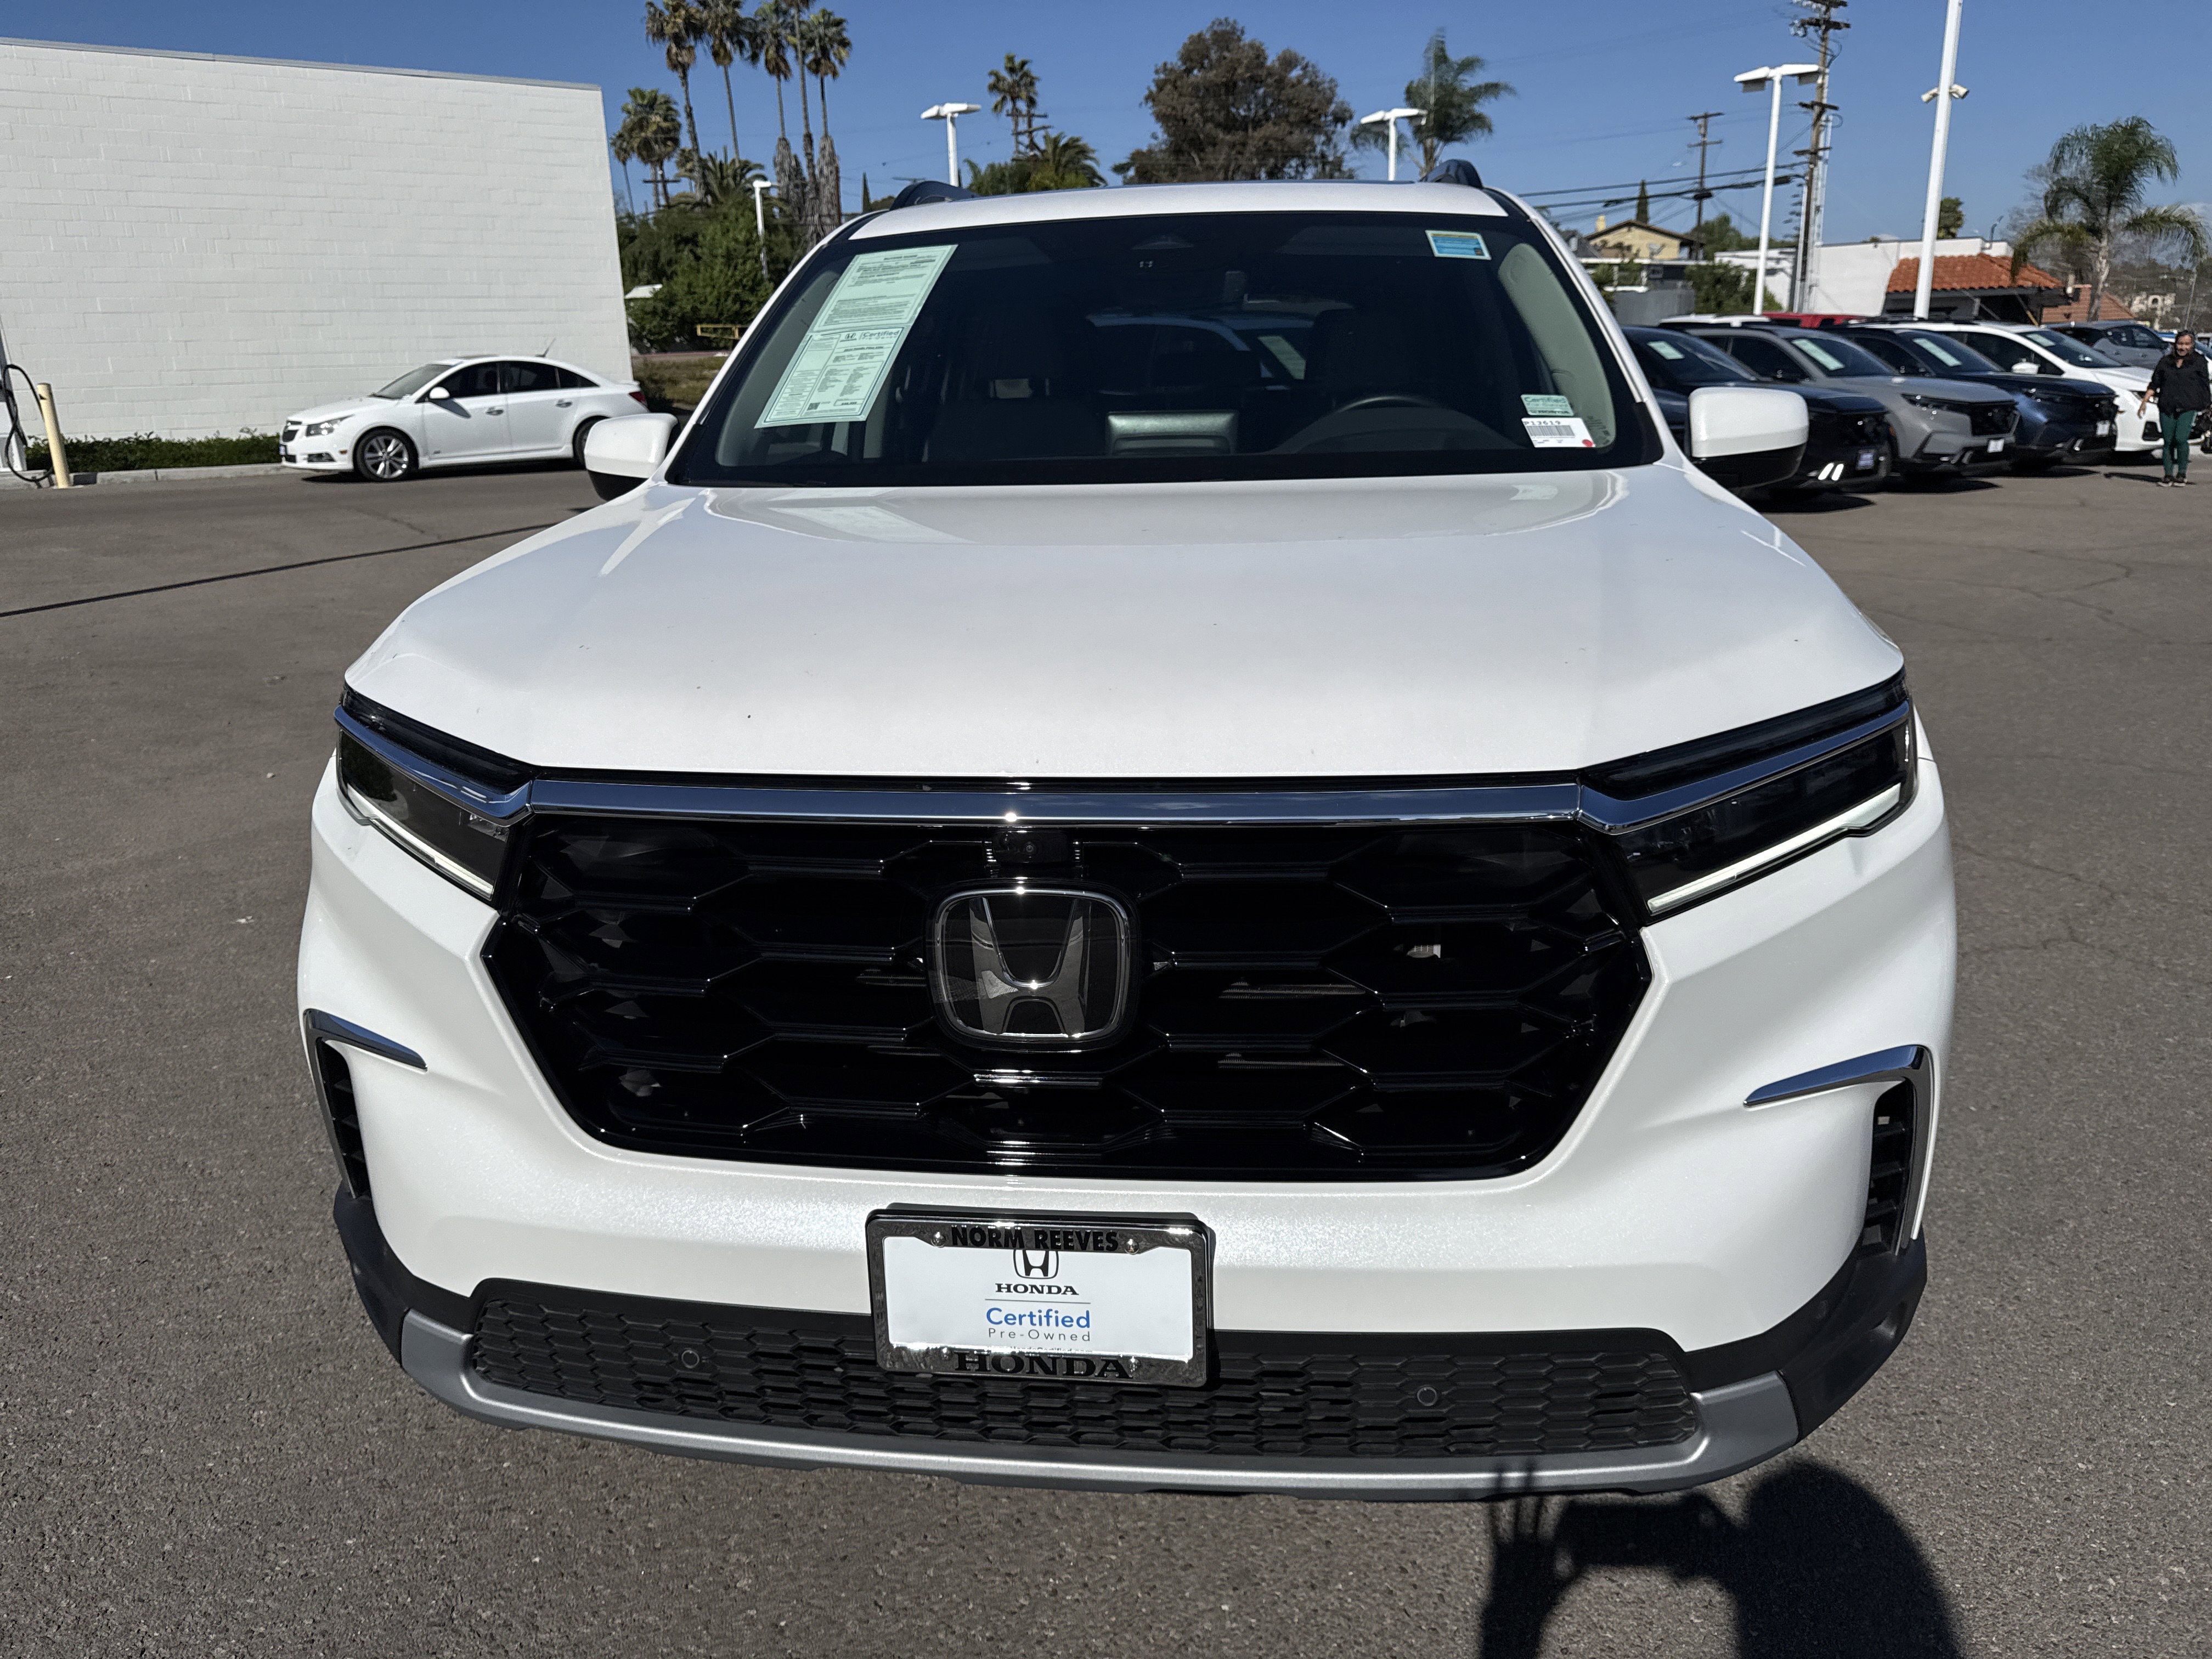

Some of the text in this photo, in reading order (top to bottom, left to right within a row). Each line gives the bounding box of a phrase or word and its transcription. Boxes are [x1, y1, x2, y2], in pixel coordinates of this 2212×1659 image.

[951, 1224, 1119, 1251] NORM REEVES
[995, 1283, 1080, 1295] HONDA
[986, 1307, 1090, 1328] Certified
[988, 1328, 1090, 1341] Pre-Owned
[953, 1350, 1133, 1379] HONDA
